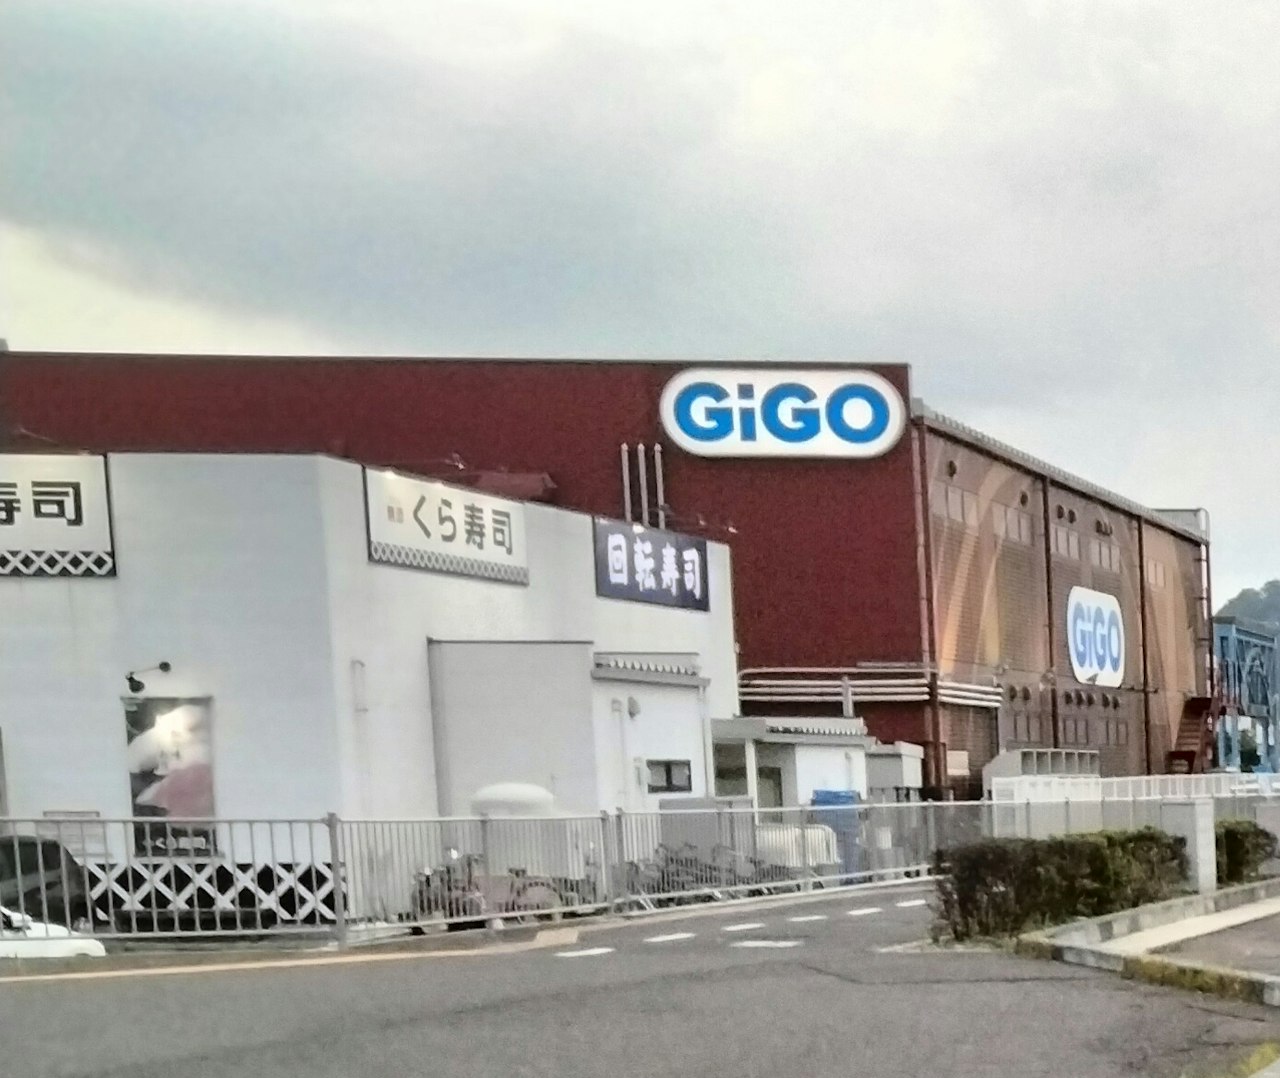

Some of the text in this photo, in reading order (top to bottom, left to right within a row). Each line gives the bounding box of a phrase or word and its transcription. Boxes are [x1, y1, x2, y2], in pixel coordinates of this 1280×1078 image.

[673, 381, 890, 444] GiGO
[412, 495, 513, 555] くら寿司
[607, 533, 701, 600] 回転寿司
[1072, 601, 1121, 673] GiGO
